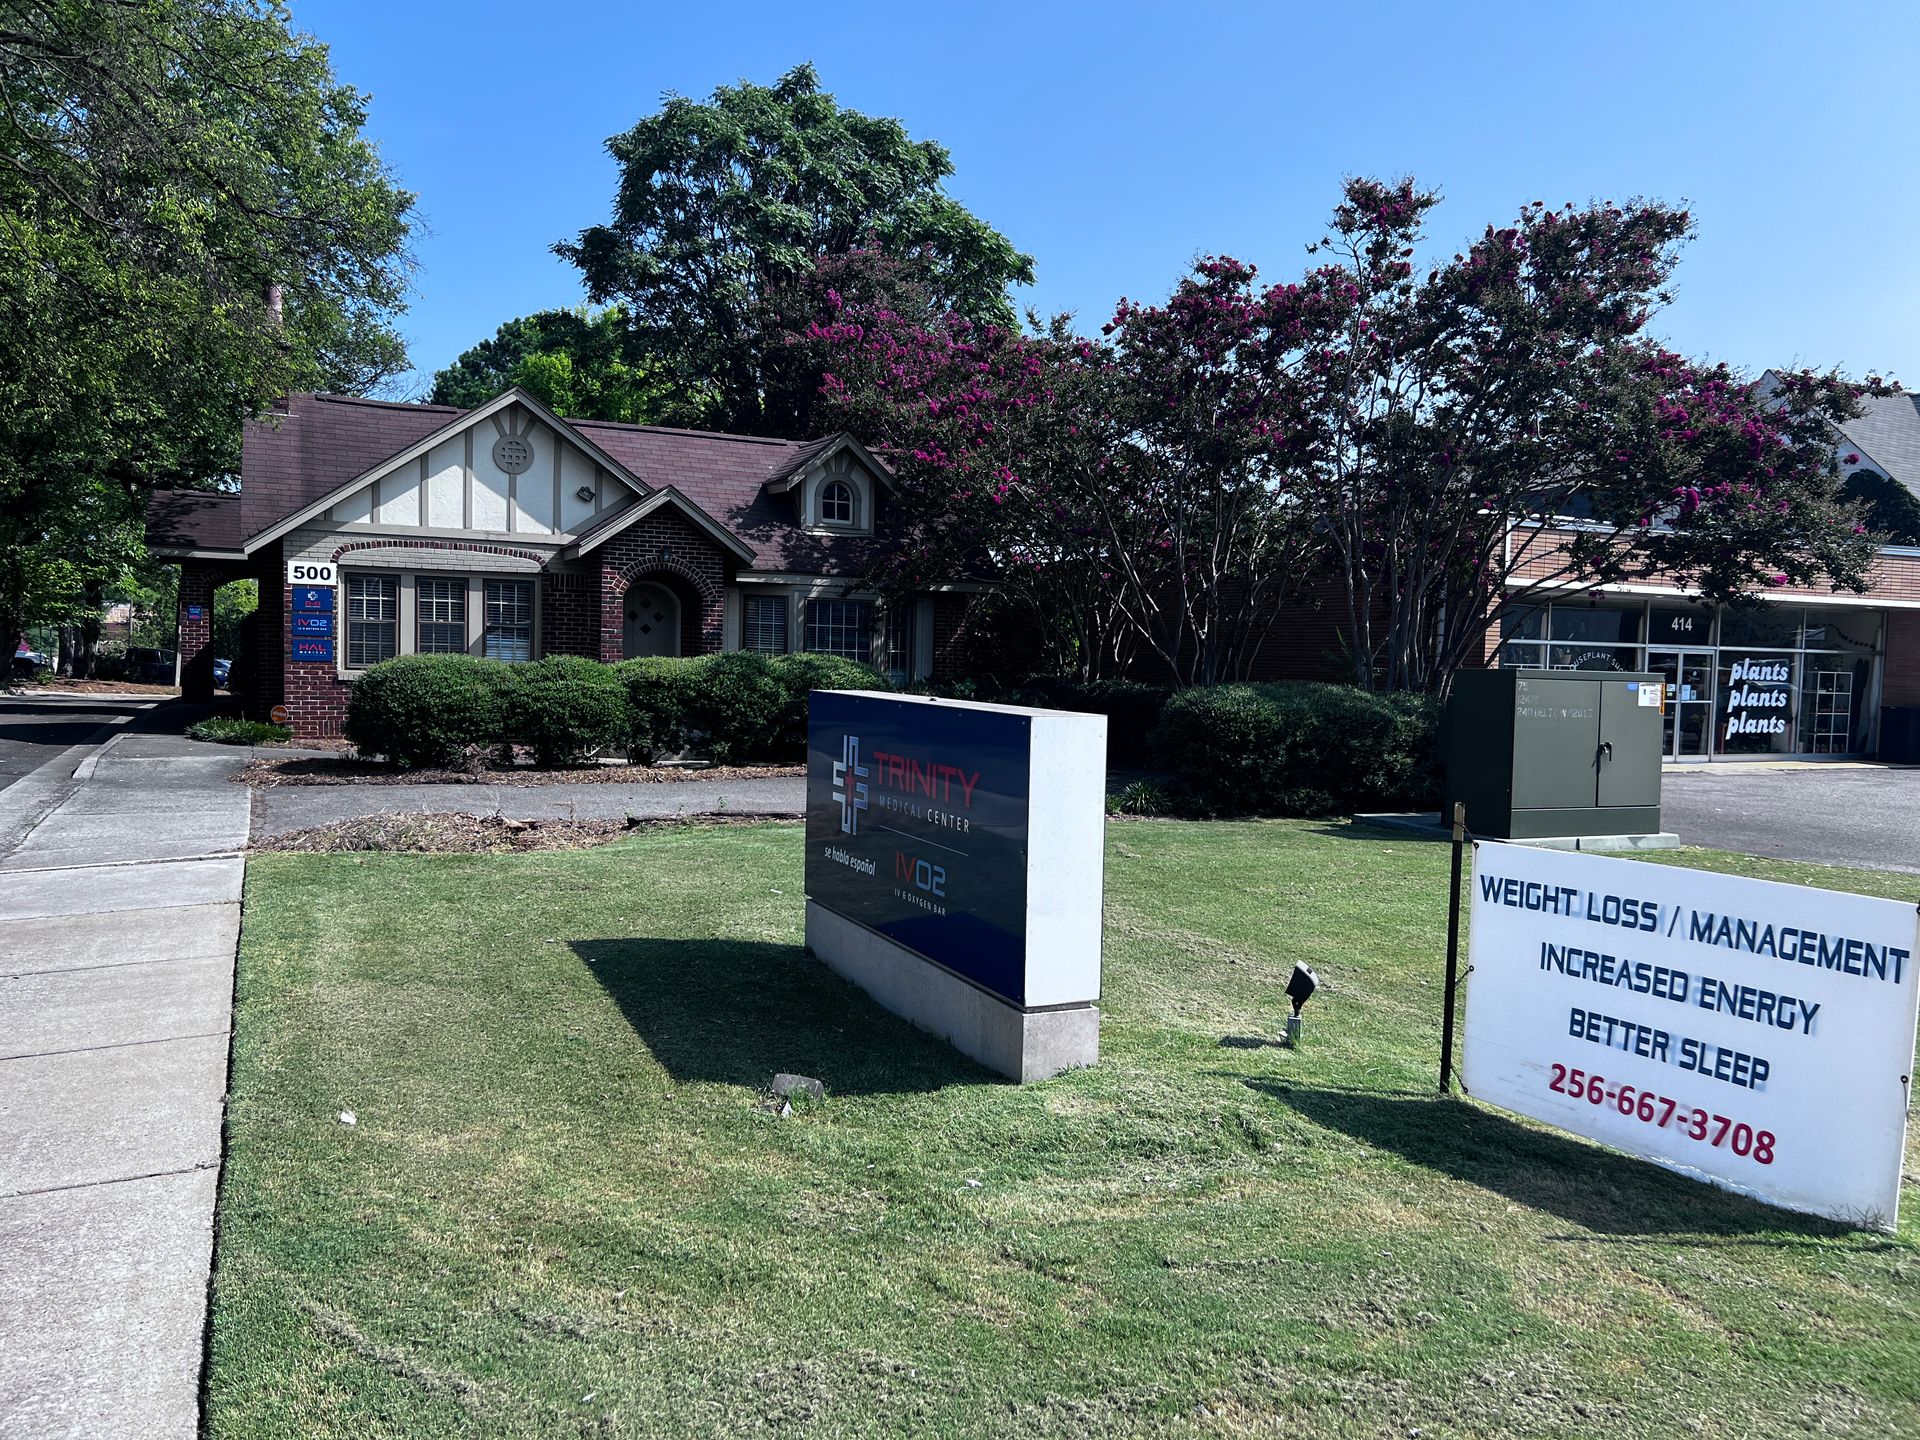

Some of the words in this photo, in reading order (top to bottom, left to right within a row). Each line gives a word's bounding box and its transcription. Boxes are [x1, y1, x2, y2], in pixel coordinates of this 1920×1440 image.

[293, 565, 332, 580] 500
[1671, 617, 1693, 631] 414
[1728, 657, 1789, 686] plants
[1726, 684, 1787, 713] plants
[1725, 711, 1786, 740] plants
[873, 751, 981, 809] TRINITY
[879, 794, 922, 819] MEDICAL
[927, 808, 970, 834] CENTER
[824, 846, 832, 859] se
[832, 846, 850, 866] habla
[850, 856, 876, 877] español
[894, 887, 901, 897] IV
[907, 893, 932, 911] OXYGEN
[933, 904, 946, 917] BAR
[1480, 874, 1578, 917] WEIGHT
[1586, 891, 1658, 933] LOSS
[1667, 905, 1681, 938] /
[1689, 909, 1910, 984] MANAGEMENT
[1540, 942, 1689, 1002] INCREASED
[1699, 976, 1821, 1035] ENERGY
[1569, 1007, 1670, 1063] BETTER
[1678, 1037, 1770, 1090] SLEEP
[1549, 1063, 1776, 1165] 256-667-3708
